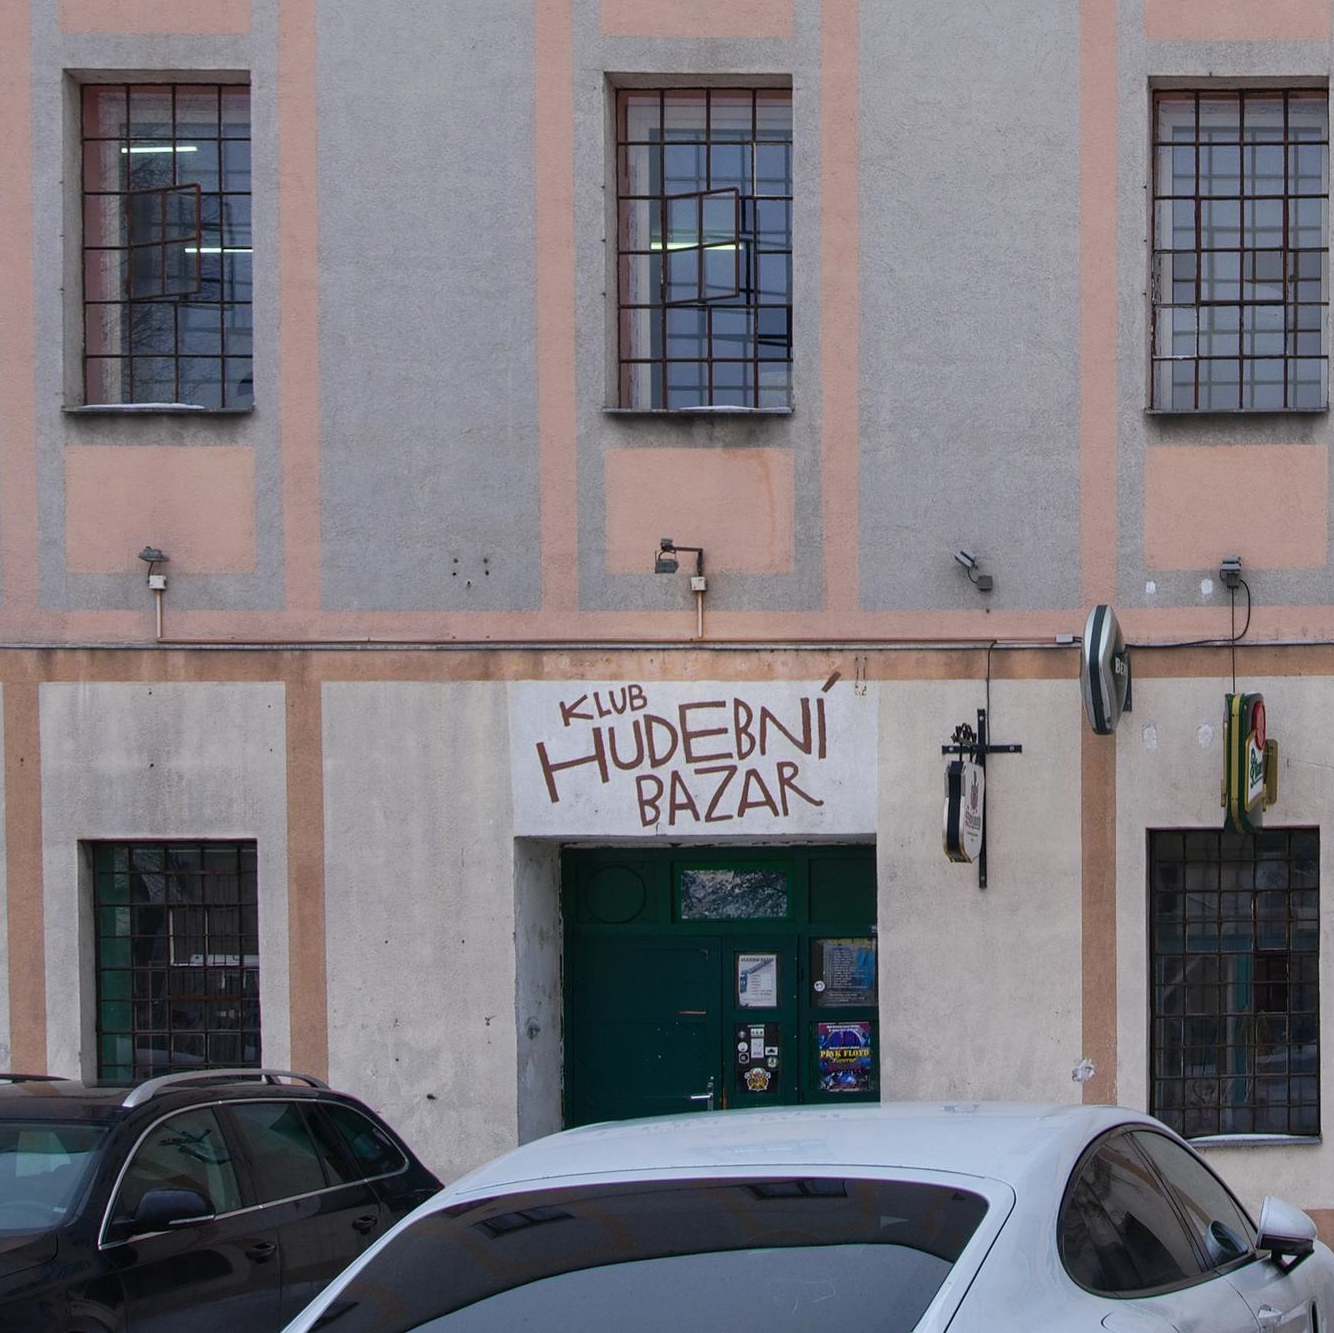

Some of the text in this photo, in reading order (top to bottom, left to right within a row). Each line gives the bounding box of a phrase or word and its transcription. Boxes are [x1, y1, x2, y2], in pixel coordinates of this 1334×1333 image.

[559, 683, 648, 727] KLUB
[535, 671, 842, 804] HUDEBNÍ
[635, 761, 825, 827] BAZAR
[820, 1049, 870, 1058] PINK FLOYD
